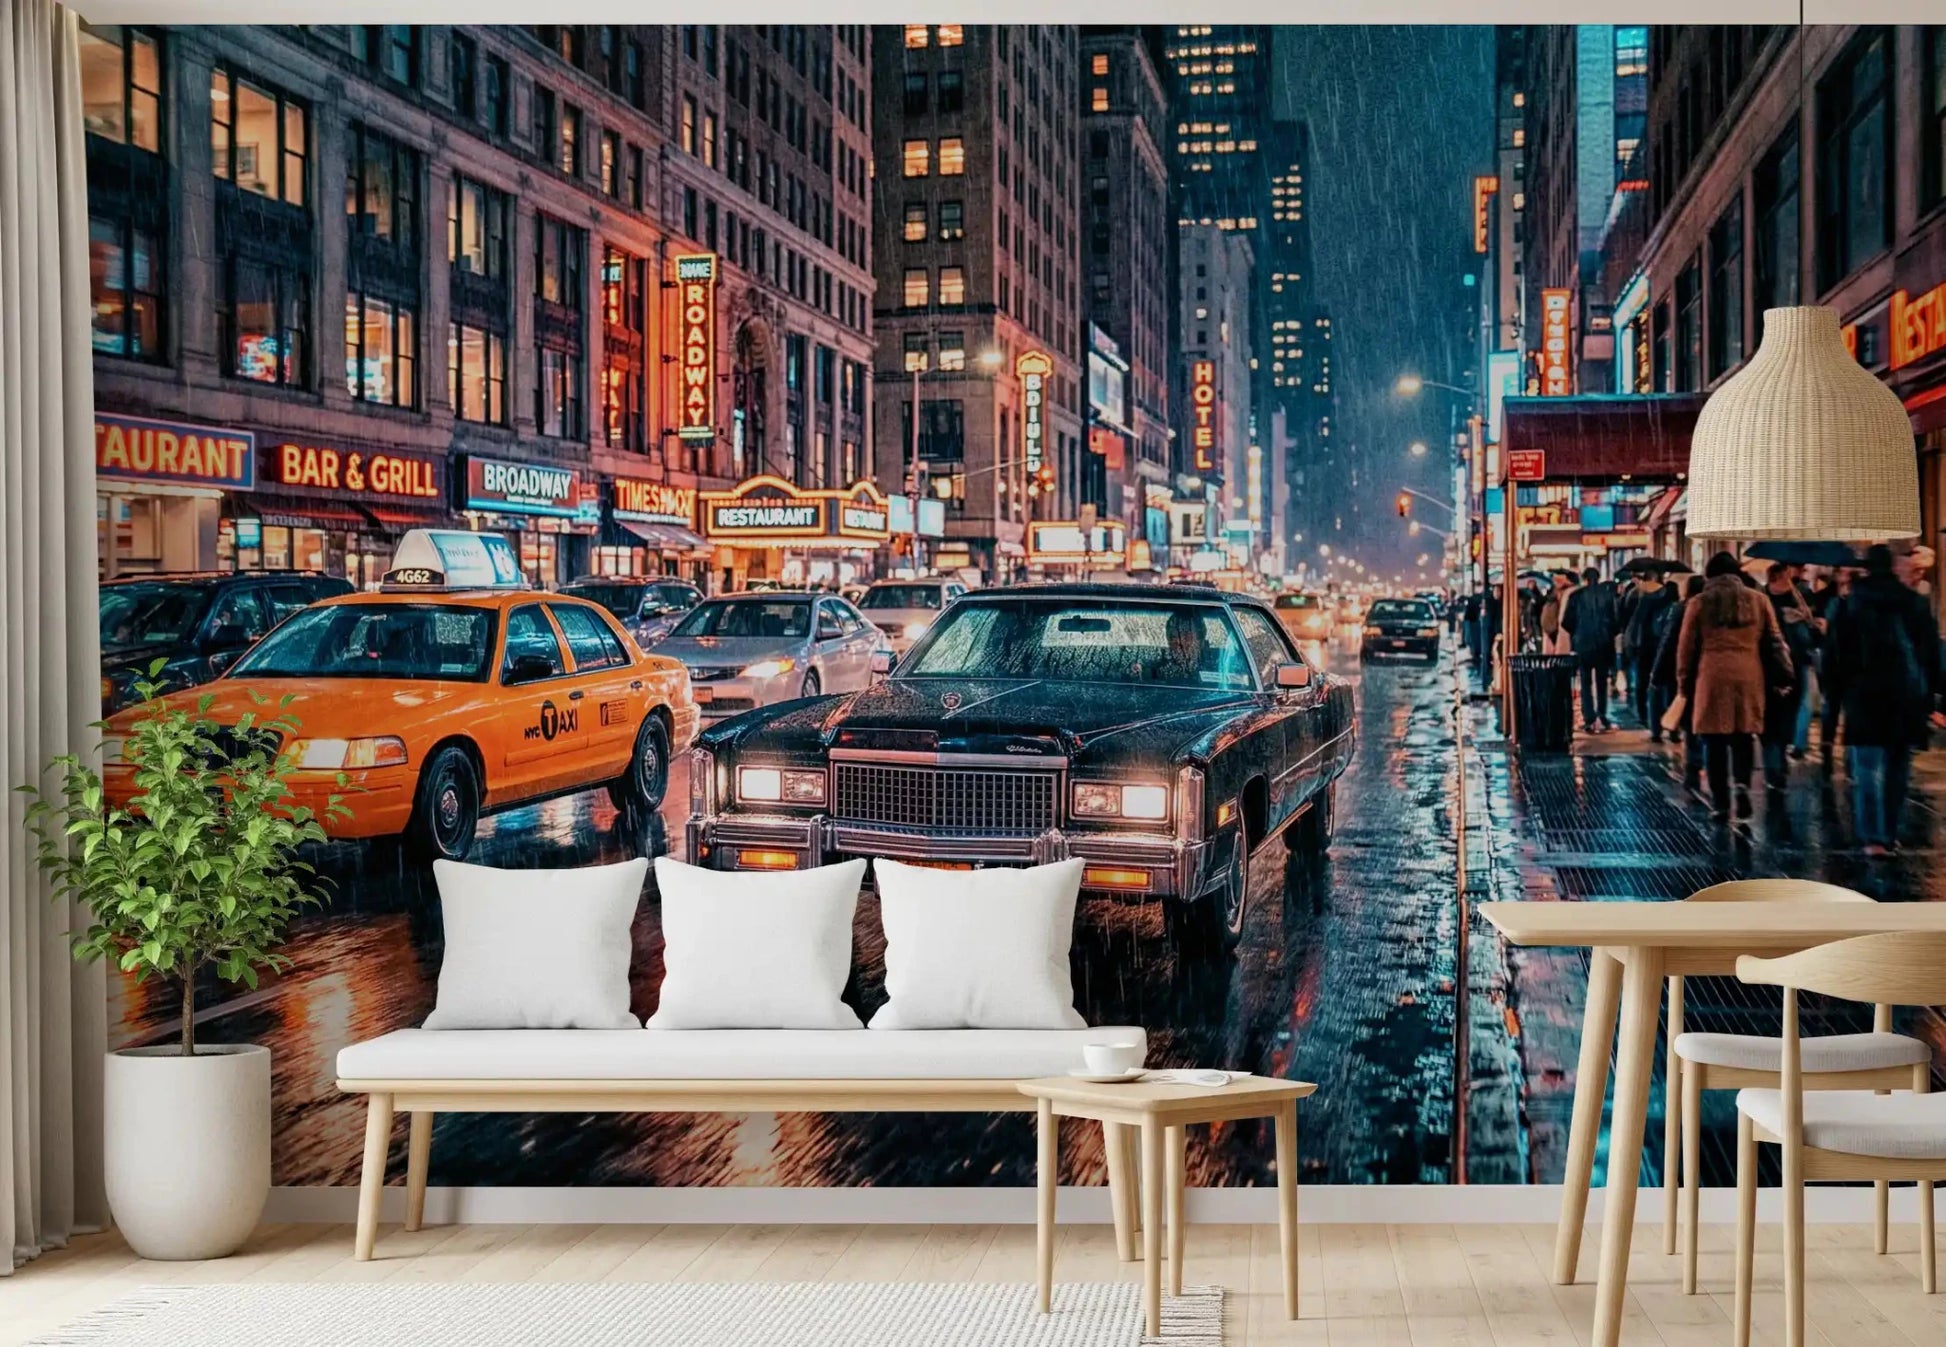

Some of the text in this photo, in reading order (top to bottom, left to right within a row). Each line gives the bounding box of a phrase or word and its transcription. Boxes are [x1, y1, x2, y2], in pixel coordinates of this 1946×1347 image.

[1195, 363, 1215, 469] HOTEL
[283, 445, 438, 496] BAR & GRILL
[484, 464, 571, 500] BROADWAY
[718, 508, 814, 526] RESTAURANT
[396, 570, 430, 584] 4G62
[524, 726, 540, 740] NYC
[541, 700, 578, 741] TAXI
